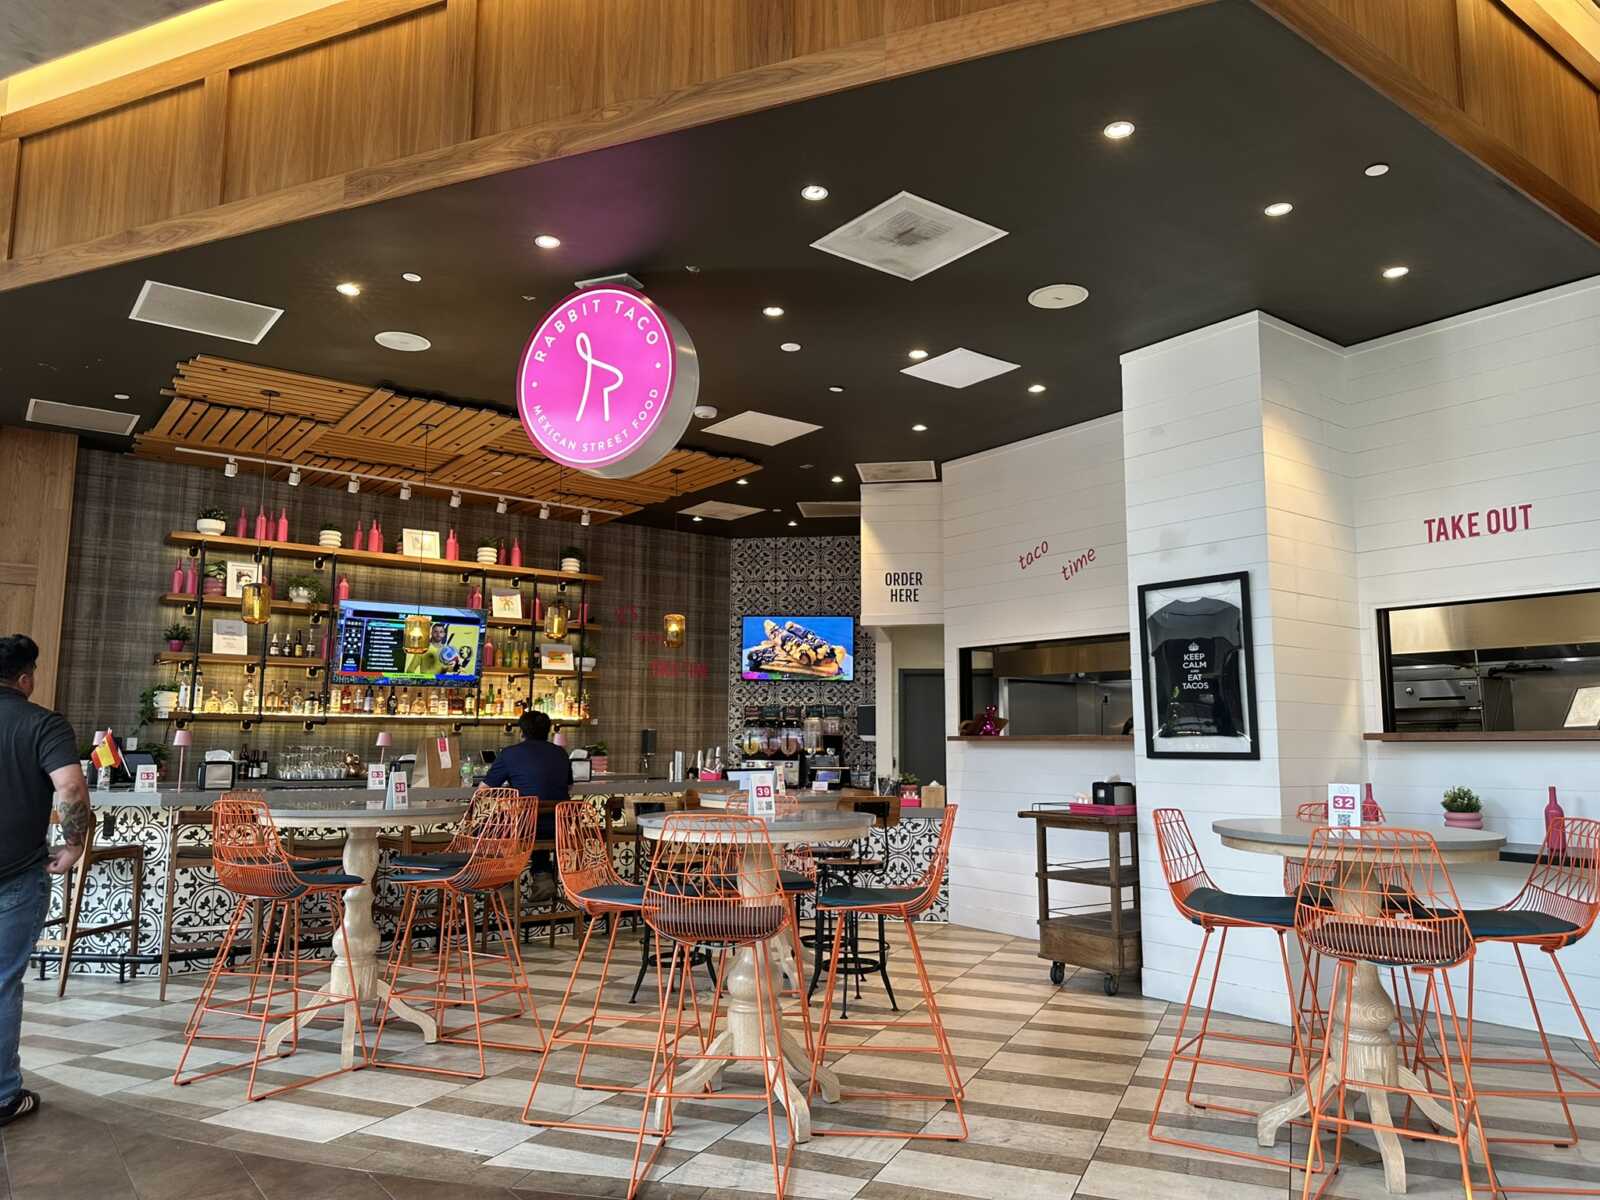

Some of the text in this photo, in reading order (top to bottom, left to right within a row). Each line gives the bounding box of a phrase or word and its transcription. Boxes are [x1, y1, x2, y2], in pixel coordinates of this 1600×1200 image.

[534, 300, 659, 363] RABBIT TACO
[533, 388, 659, 453] MEXICAN STREET FOOD
[1424, 504, 1532, 544] TAKE OUT
[1017, 540, 1049, 571] taco
[1061, 547, 1097, 582] time
[885, 572, 923, 586] ORDER
[890, 588, 919, 602] HERE
[1183, 653, 1206, 661] KEEP
[1182, 661, 1207, 669] CALM
[1187, 674, 1203, 682] EAT
[1182, 682, 1209, 690] TACOS
[757, 786, 771, 797] 39
[1334, 797, 1354, 808] 32
